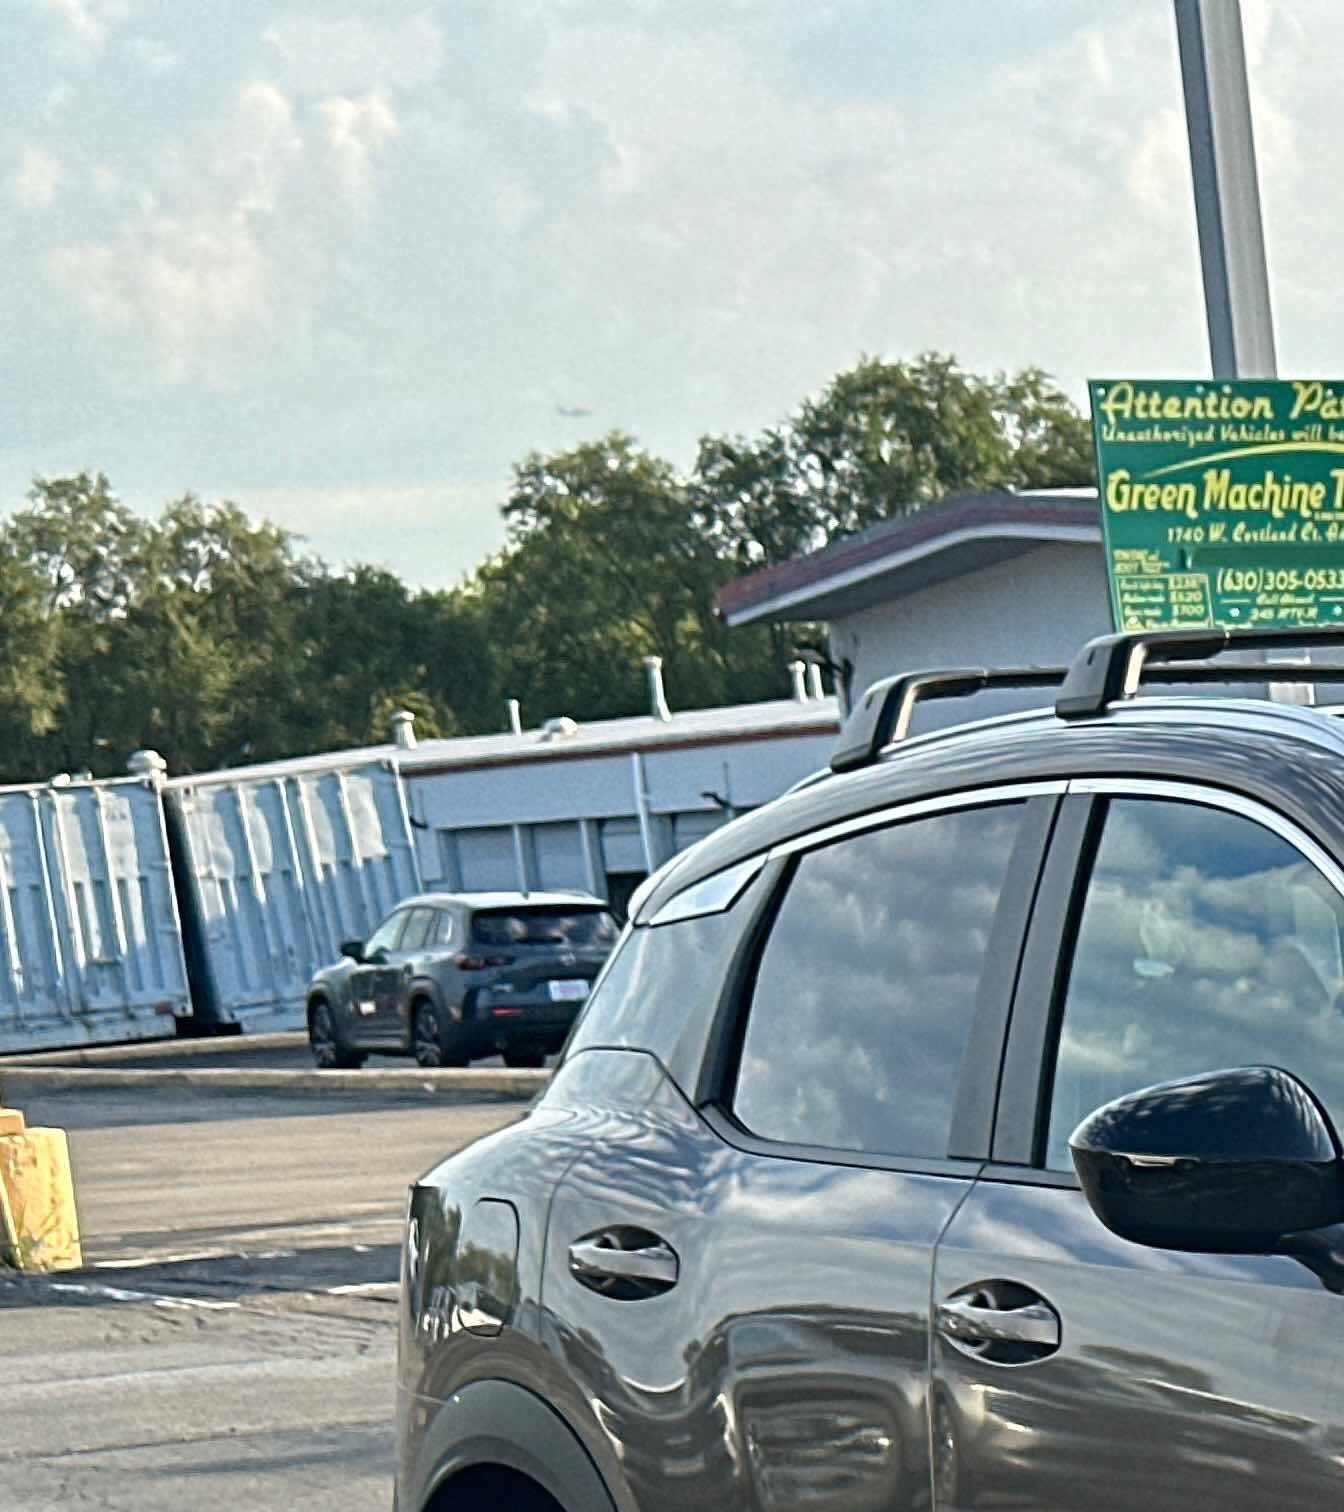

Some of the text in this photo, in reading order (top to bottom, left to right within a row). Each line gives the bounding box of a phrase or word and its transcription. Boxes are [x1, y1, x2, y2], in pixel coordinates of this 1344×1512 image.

[1100, 382, 1274, 424] Attention
[1102, 424, 1215, 447] Unauthorized
[1221, 423, 1285, 442] Vehicles
[1291, 423, 1322, 441] will
[1106, 468, 1199, 519] Green
[1203, 467, 1325, 520] Machine
[1167, 527, 1204, 543] 1740
